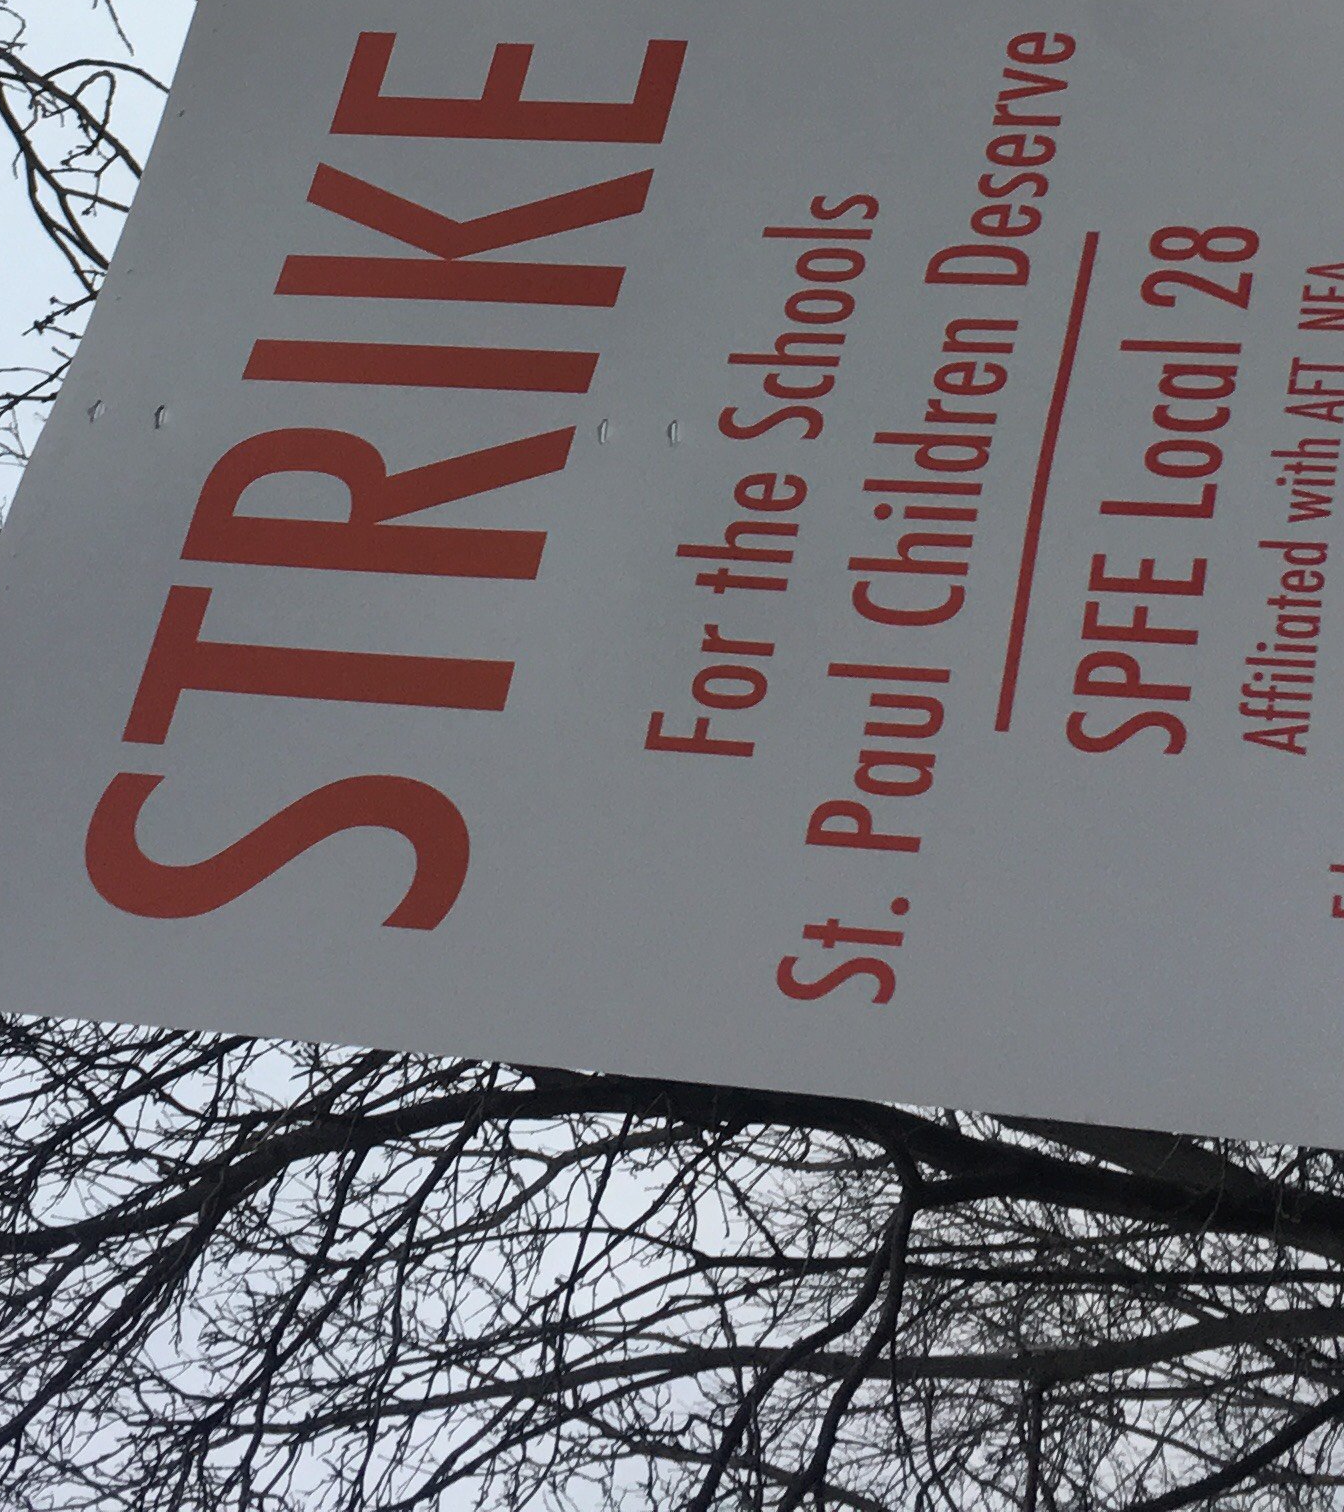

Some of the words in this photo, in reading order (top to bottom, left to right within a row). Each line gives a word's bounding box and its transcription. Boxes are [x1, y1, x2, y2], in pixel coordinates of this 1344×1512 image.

[924, 31, 1076, 287] Deserve
[718, 193, 880, 440] Schools
[1139, 225, 1260, 310] 28
[84, 31, 688, 931] STRIKE
[848, 318, 1019, 627] Children
[1098, 338, 1242, 520] Local
[1271, 437, 1341, 523] with
[676, 472, 809, 595] the
[643, 623, 775, 757] For
[1064, 552, 1208, 755] SPFE
[1238, 539, 1328, 756] Affiliated
[804, 662, 951, 853] Paul
[776, 896, 911, 1005] St.
